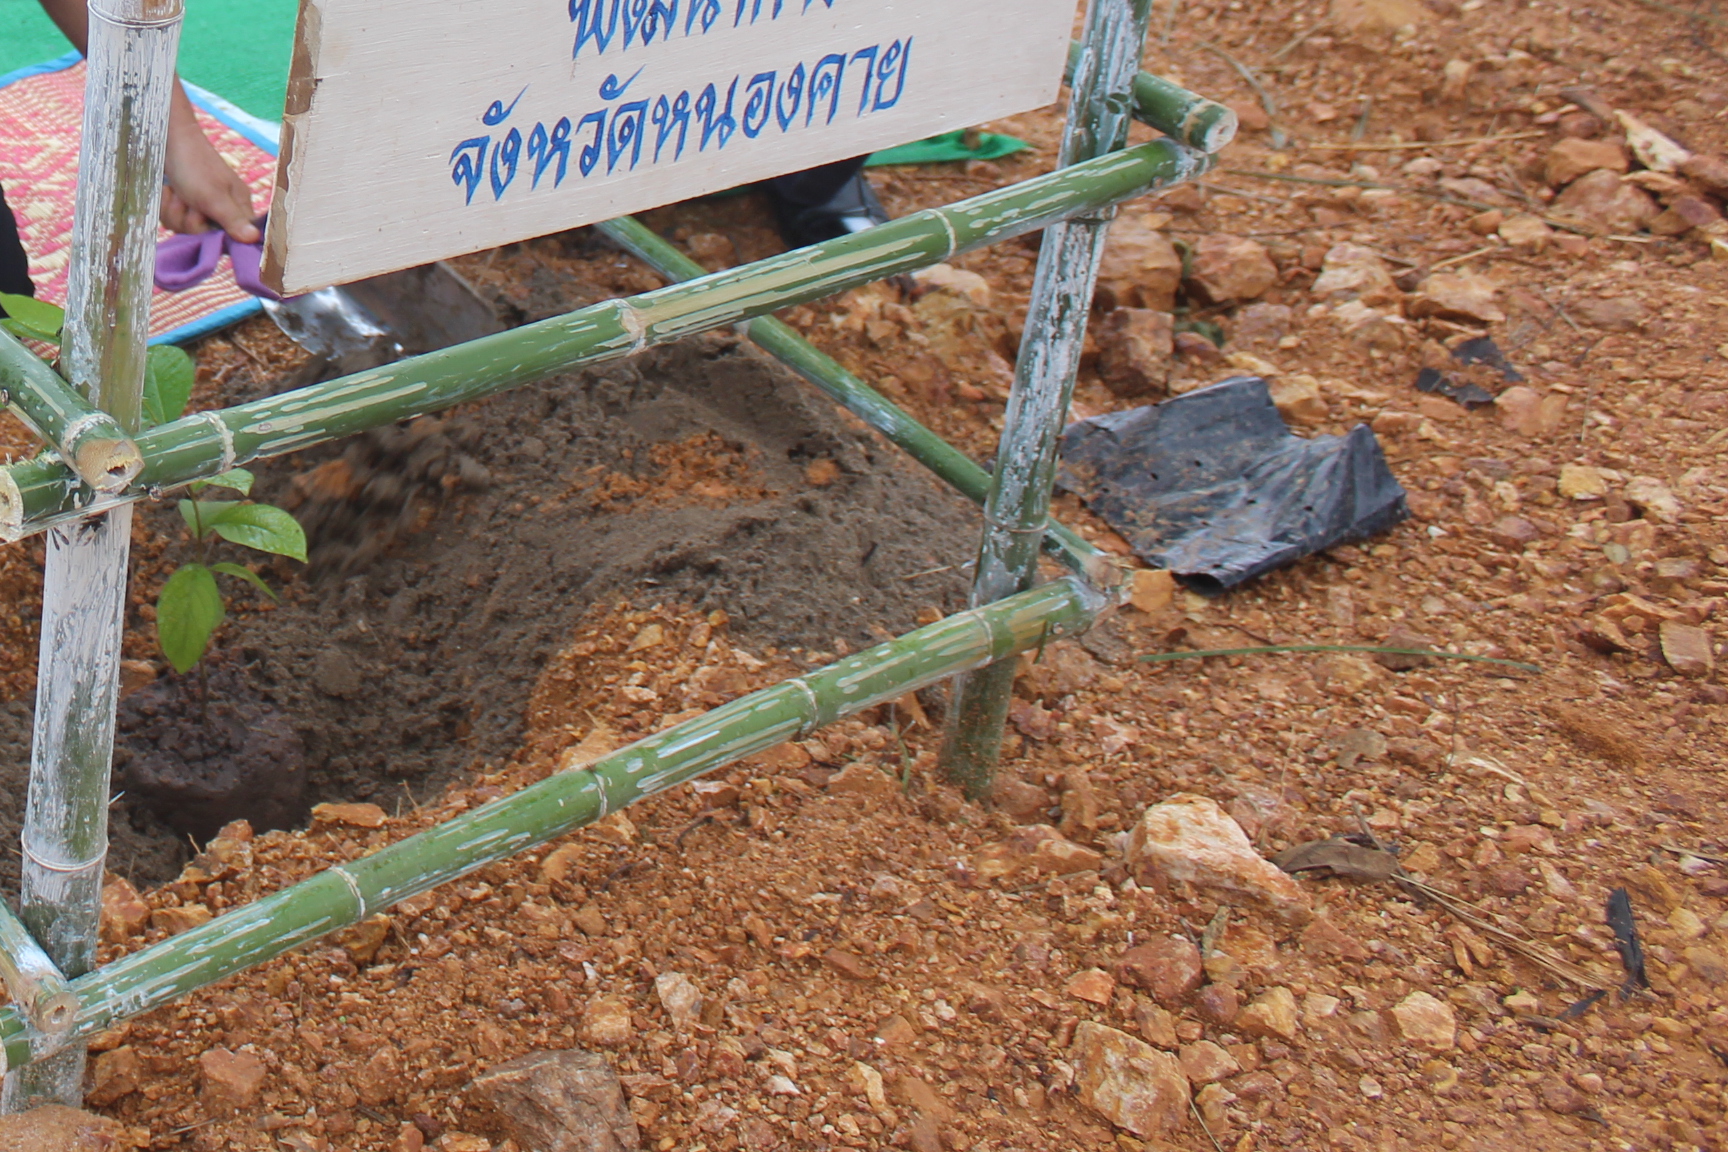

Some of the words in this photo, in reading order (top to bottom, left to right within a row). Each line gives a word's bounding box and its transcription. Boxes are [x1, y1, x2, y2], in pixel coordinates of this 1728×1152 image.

[448, 35, 913, 206] จังหวัดหนองคาย
